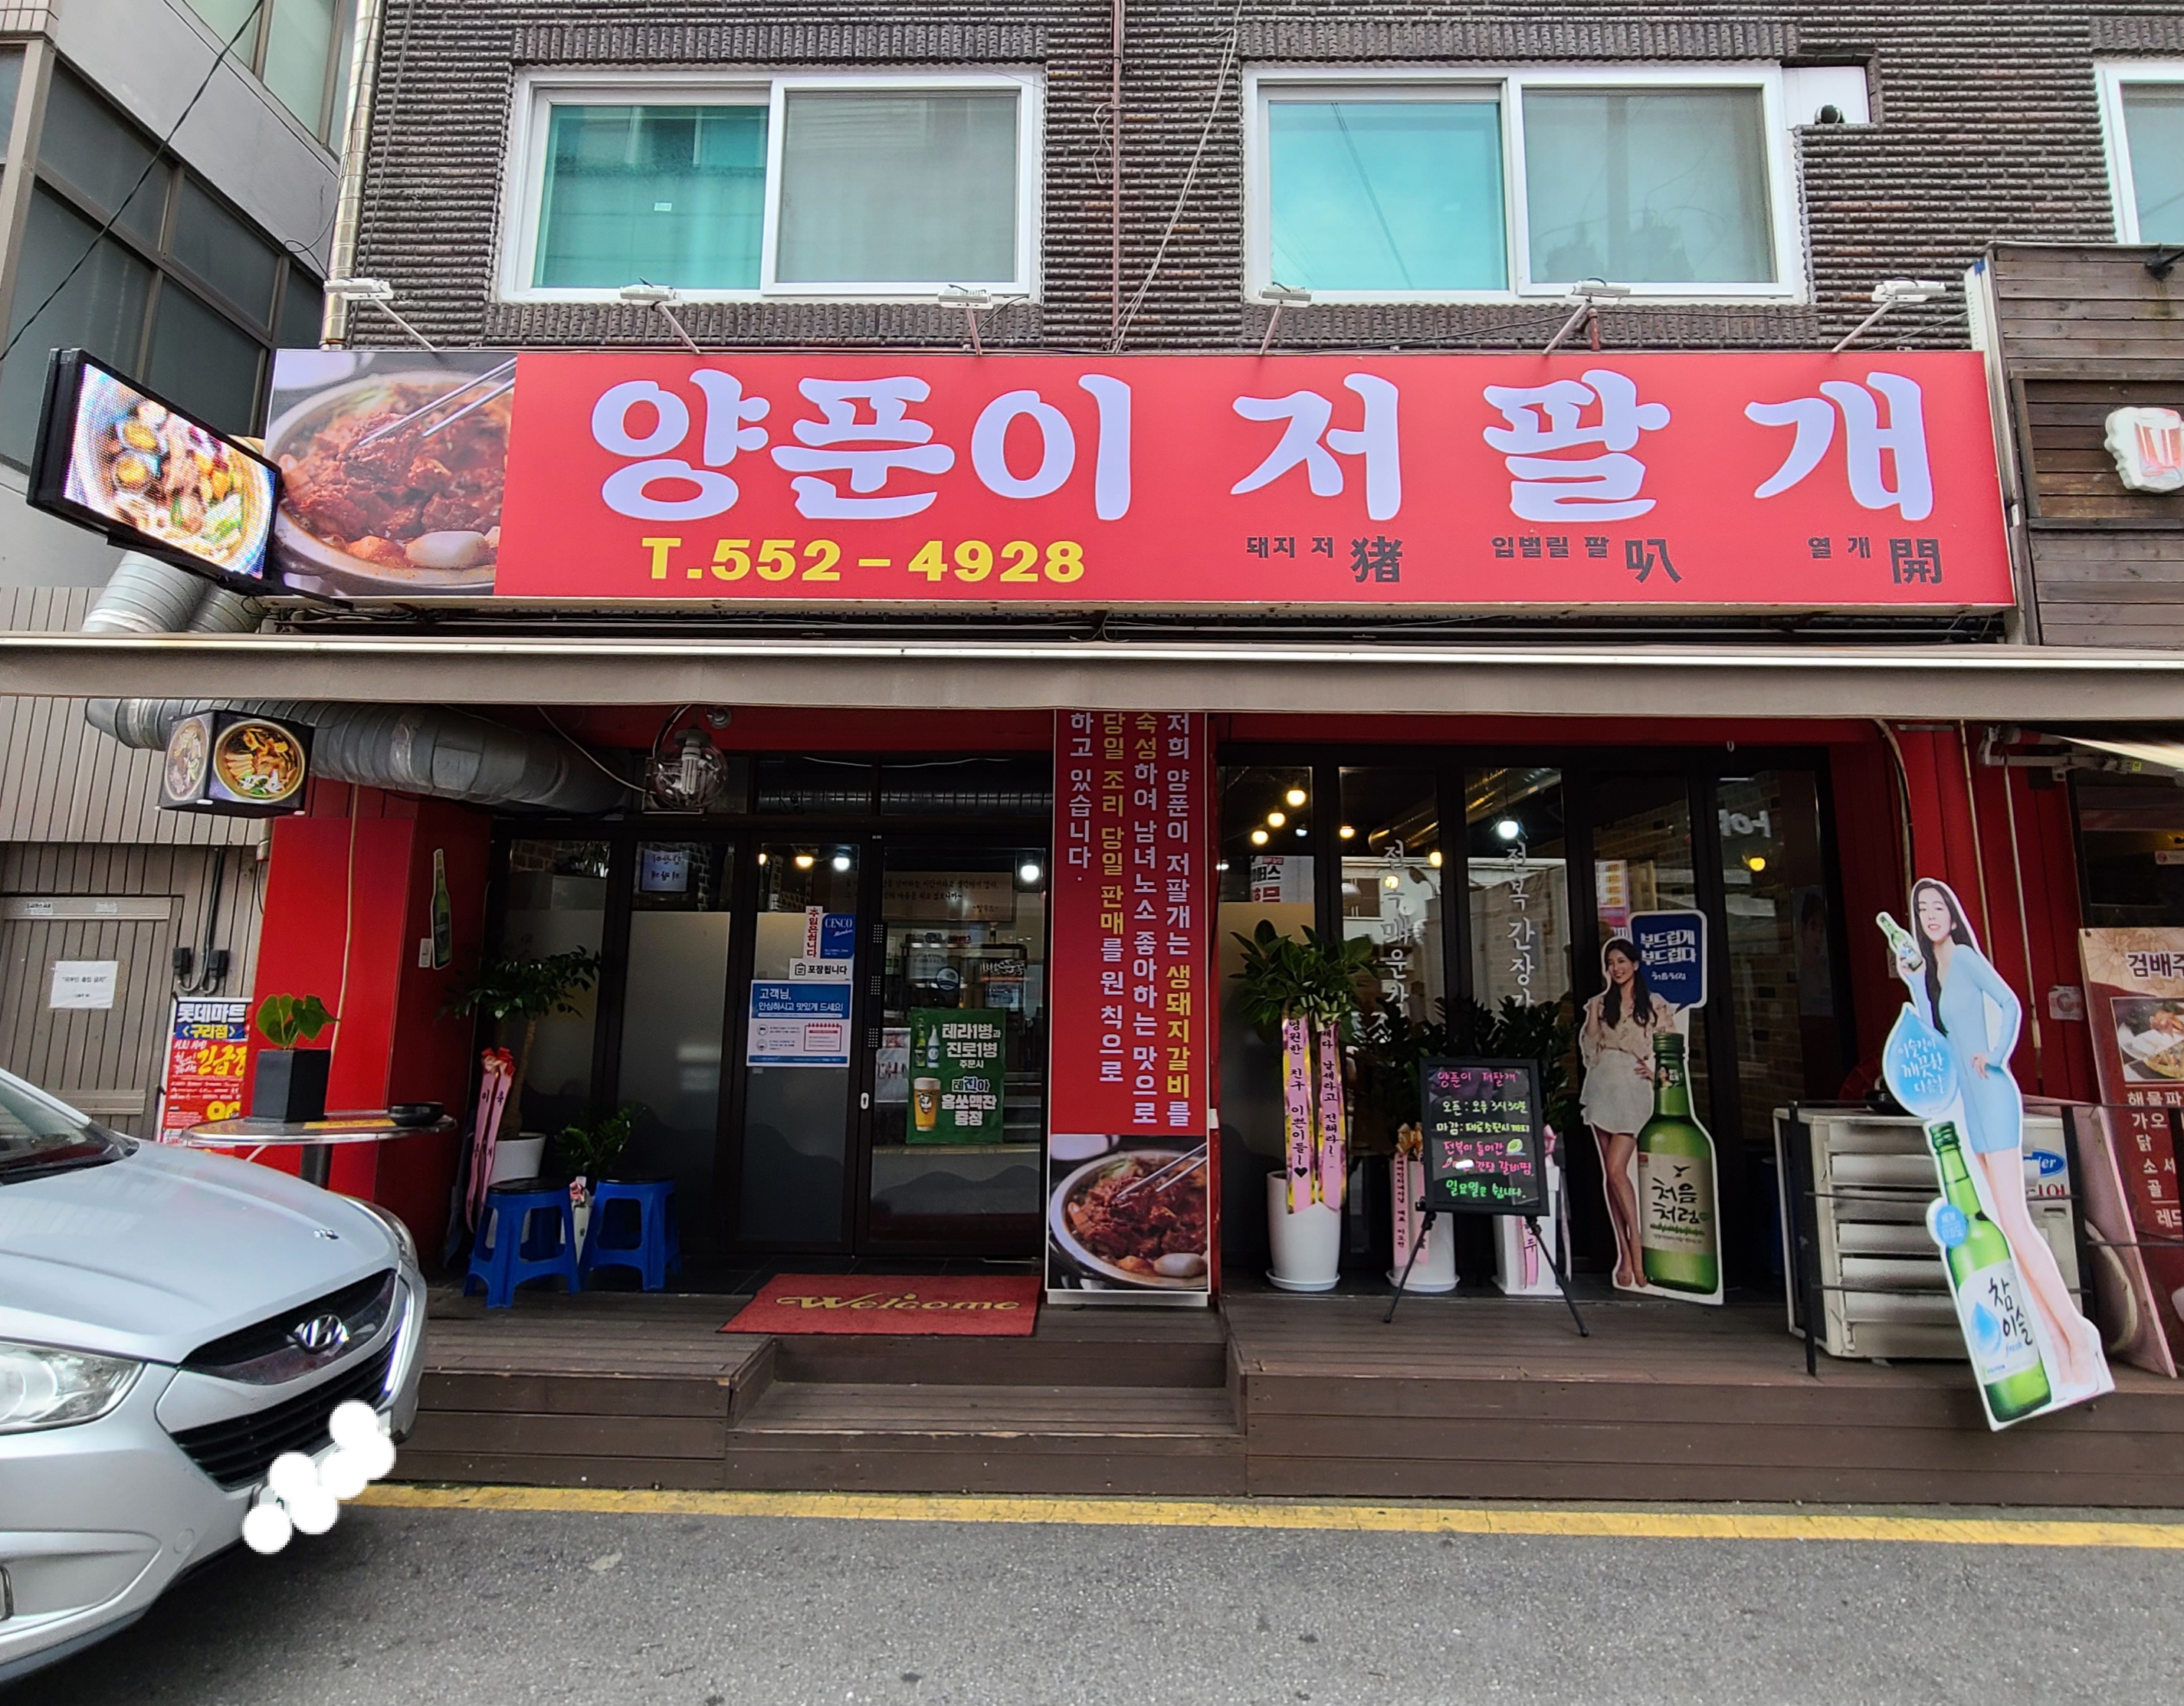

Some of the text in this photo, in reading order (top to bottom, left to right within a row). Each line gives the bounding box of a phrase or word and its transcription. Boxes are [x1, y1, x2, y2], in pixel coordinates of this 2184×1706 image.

[590, 368, 1132, 521] 양푼이
[1246, 536, 1296, 559] 돼지
[1311, 536, 1333, 559] 저
[1490, 536, 1569, 559] 입벌릴
[1808, 536, 1943, 585] 열 개 開
[1070, 713, 1094, 756] 하고
[1103, 713, 1126, 759] 당일
[1102, 769, 1125, 817] 조리
[1101, 827, 1124, 876] 당일
[825, 918, 852, 928] CESCO
[1100, 885, 1124, 963] 판매를
[1133, 713, 1158, 1124] 숙성하여 남녀노소 좋아하는 맛으로
[1166, 713, 1191, 1127] 저희 양푼이 저팔개는 생돼지갈비를
[1640, 930, 1695, 949] 부드럽게
[1641, 947, 1696, 966] 부드럽다
[808, 965, 848, 975] 포장됩니다
[177, 1003, 246, 1023] 롯데마트
[759, 1002, 794, 1011] 안심하시고
[796, 1002, 818, 1011] 맛있게
[959, 1060, 984, 1068] 주문시
[1438, 1071, 1517, 1088] 양푼이 저팔개
[955, 1111, 982, 1126] 증정
[1443, 1140, 1504, 1156] 전복이 들어간
[1476, 1161, 1495, 1173] 간장
[1446, 1179, 1487, 1197] 일요일은
[1651, 1177, 1697, 1203] 처음
[1651, 1202, 1700, 1224] 처럼
[776, 1291, 1020, 1311] Welcome
